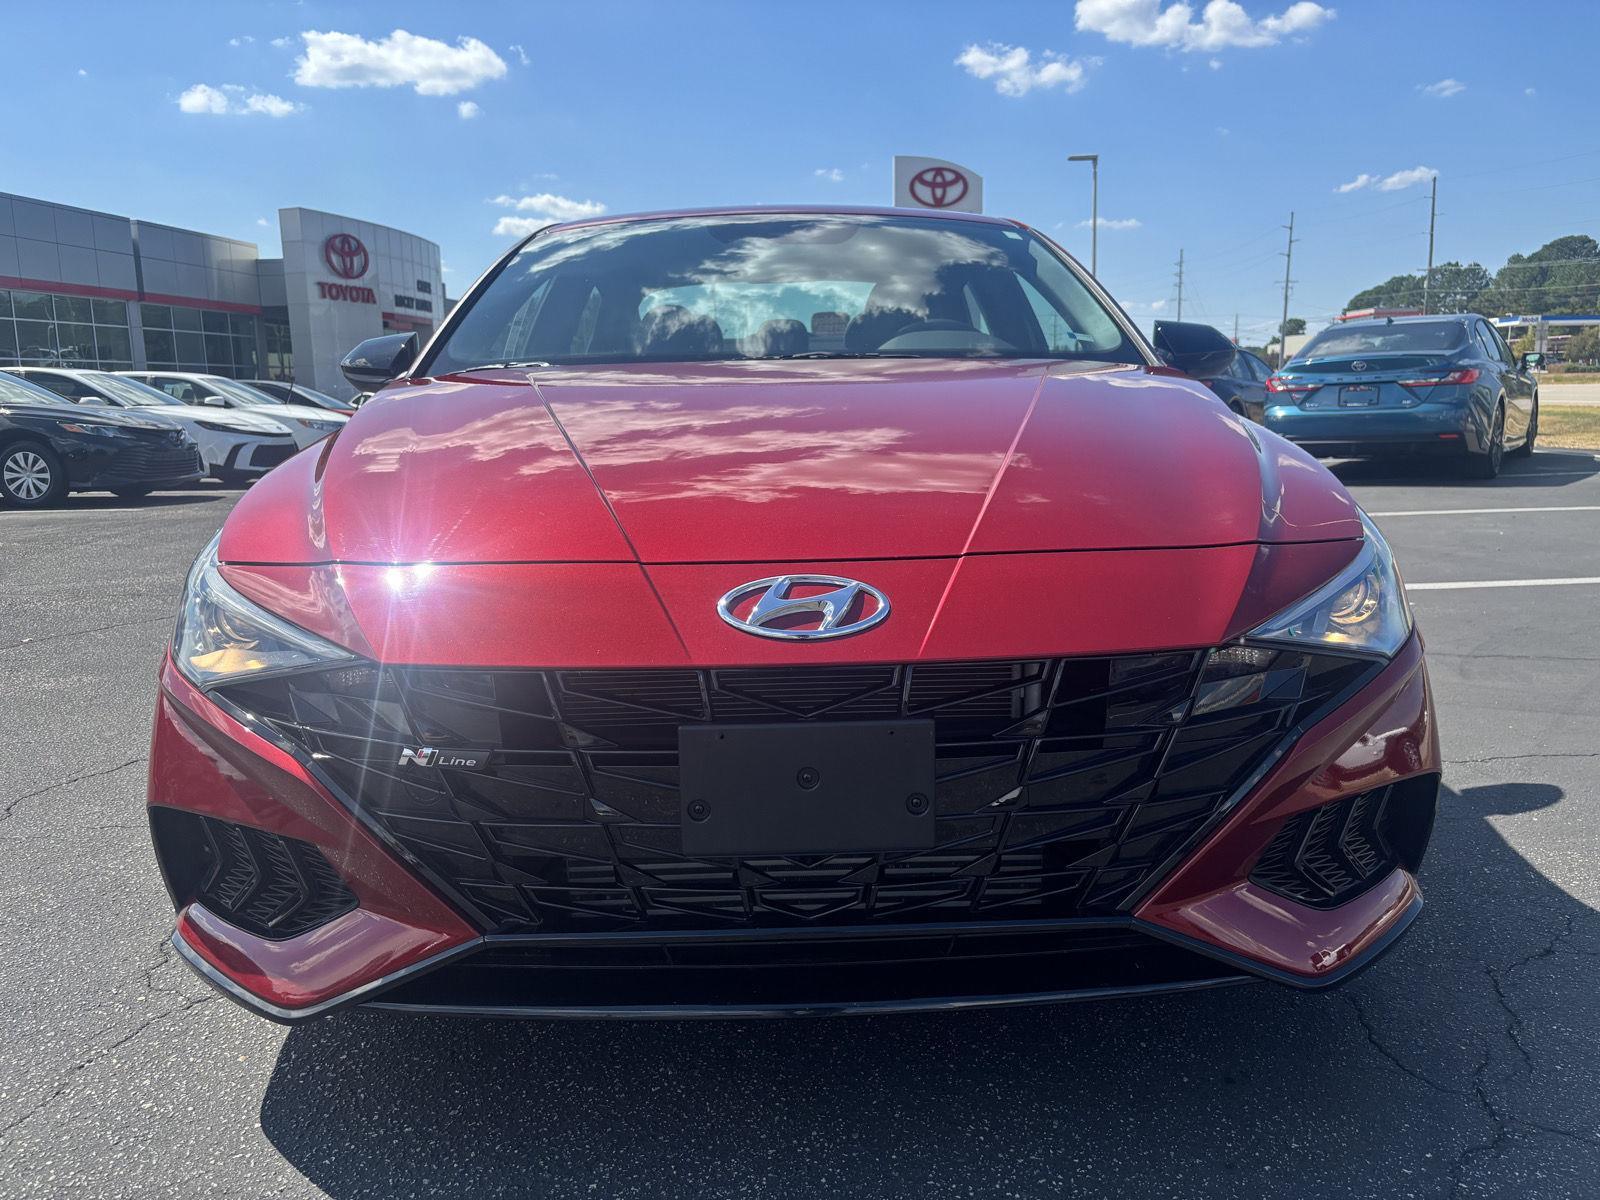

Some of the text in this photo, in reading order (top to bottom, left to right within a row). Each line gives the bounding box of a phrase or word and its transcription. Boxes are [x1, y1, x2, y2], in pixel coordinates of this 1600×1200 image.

[316, 281, 377, 305] TOYOTA
[398, 747, 477, 767] N Line
